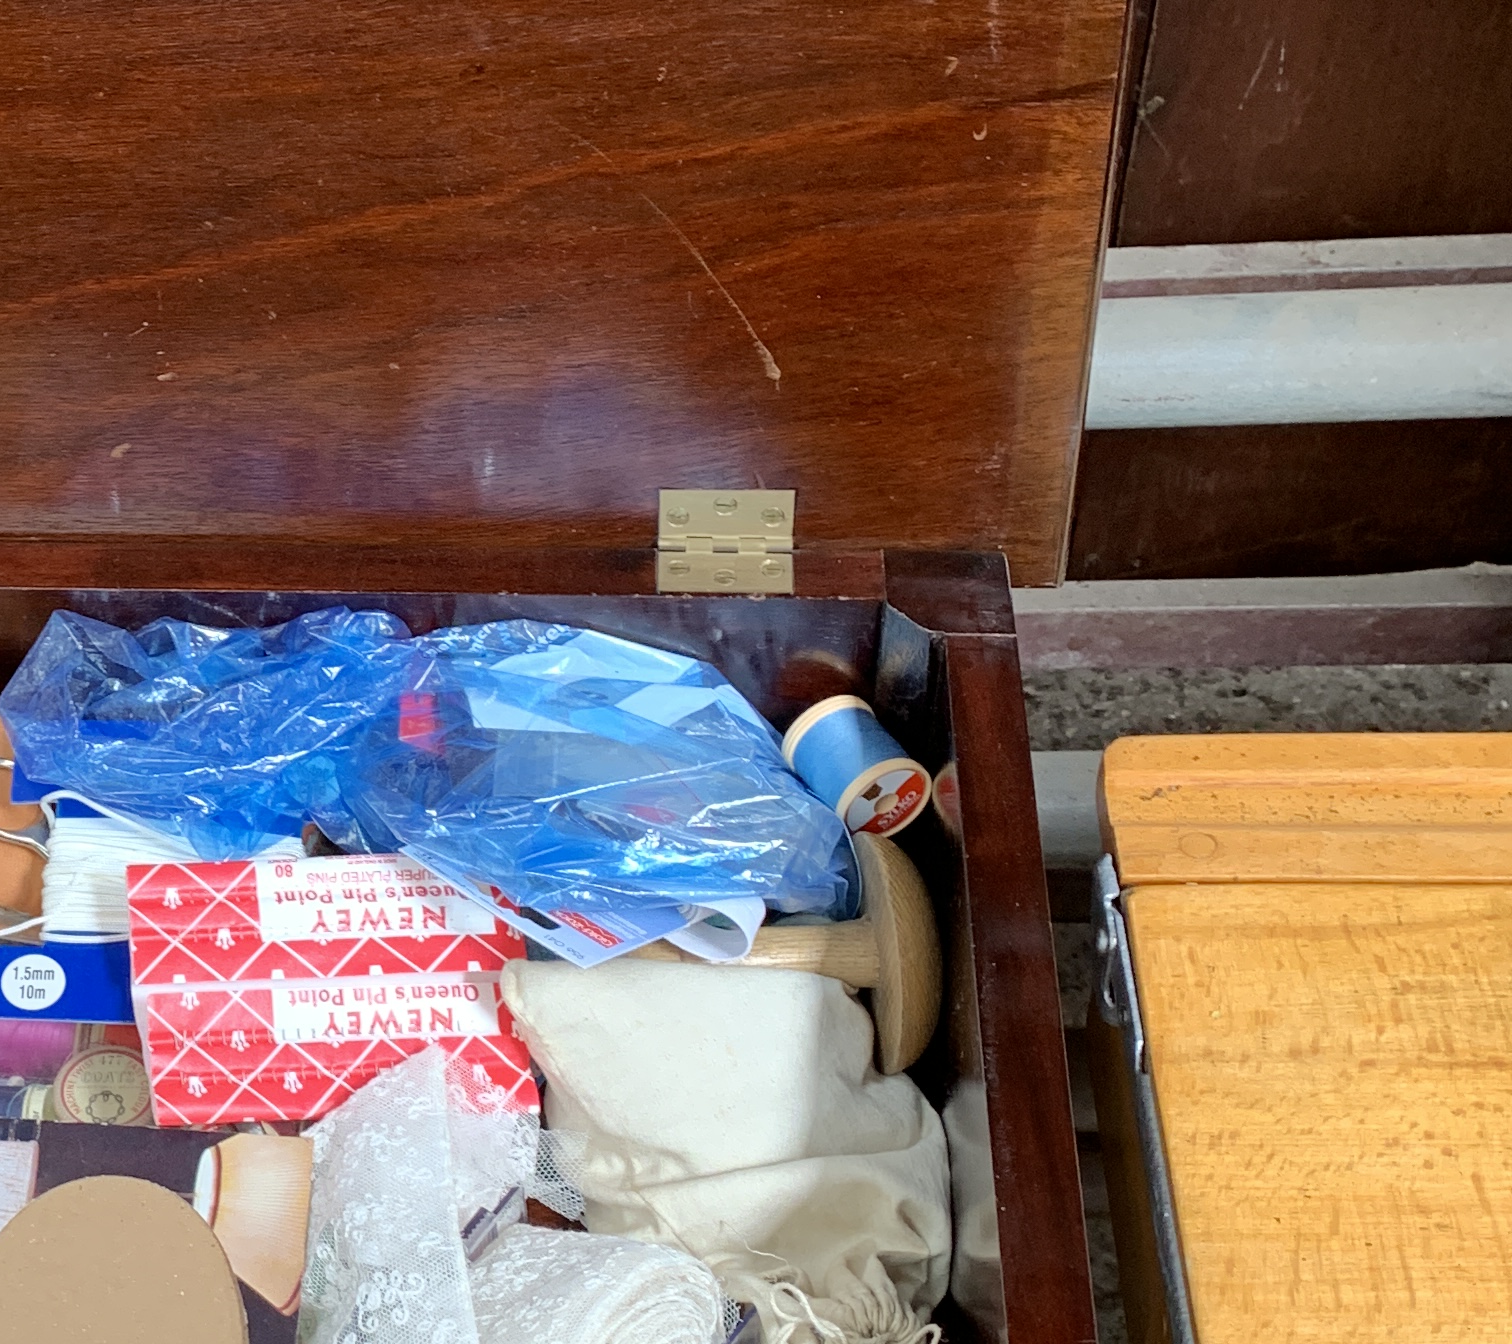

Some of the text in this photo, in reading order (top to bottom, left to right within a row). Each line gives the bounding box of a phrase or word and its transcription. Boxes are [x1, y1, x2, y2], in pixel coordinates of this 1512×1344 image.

[275, 865, 293, 878] 80
[306, 872, 338, 885] PINS
[341, 870, 390, 884] PLATED
[274, 889, 335, 906] Point
[341, 887, 378, 904] Pin
[310, 904, 447, 934] NEWEY
[13, 966, 55, 981] 1.5mm
[19, 985, 46, 1000] 10m
[288, 984, 479, 1008] Queen's Pin Point
[324, 1007, 454, 1037] NEWEY
[80, 1070, 136, 1084] COATS
